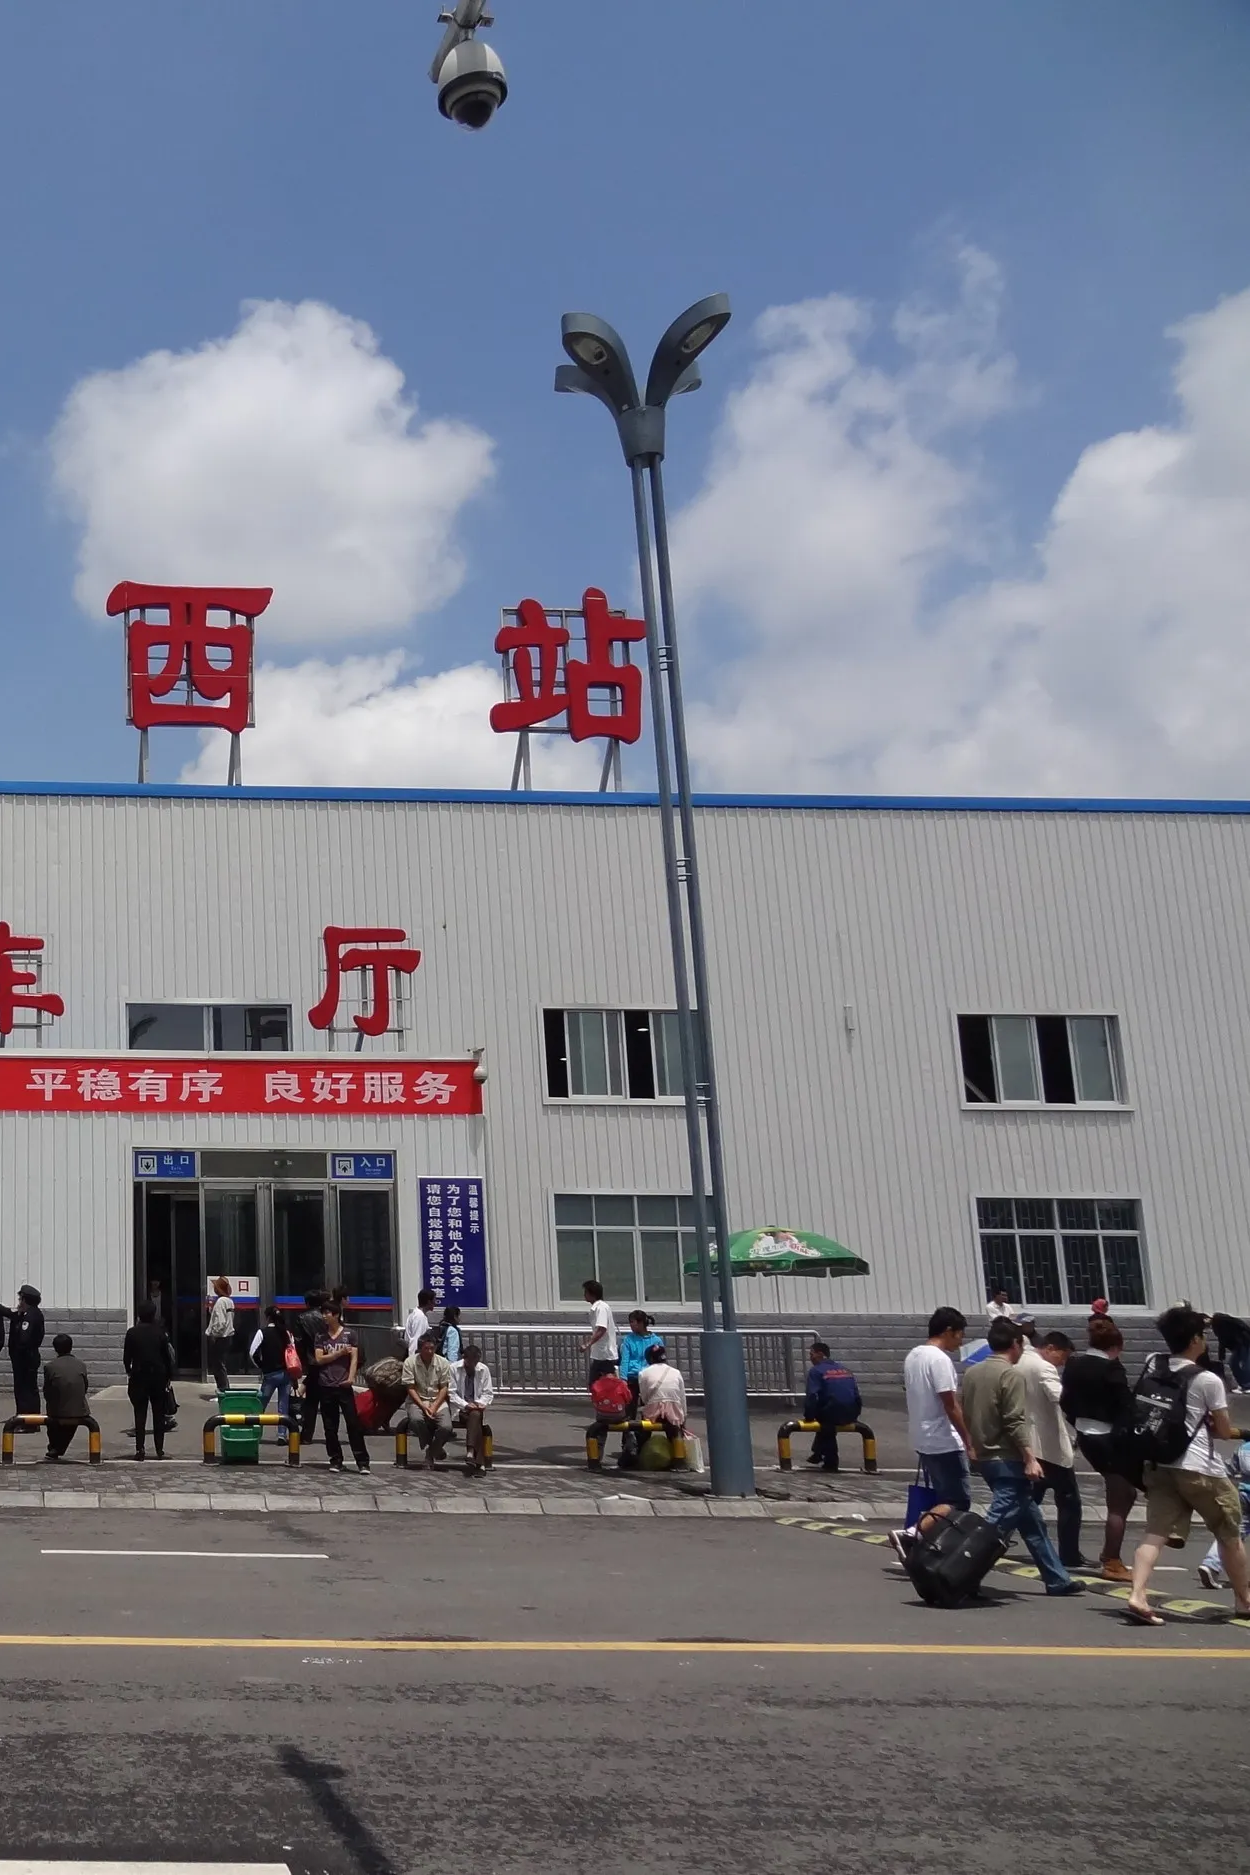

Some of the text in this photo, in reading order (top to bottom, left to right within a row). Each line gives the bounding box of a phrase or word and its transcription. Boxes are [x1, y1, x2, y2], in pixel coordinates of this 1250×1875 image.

[25, 1067, 224, 1104] 平稳有序
[264, 1070, 458, 1106] 良好服务
[163, 1154, 189, 1165] 出口
[360, 1156, 386, 1167] 入口
[468, 1184, 480, 1234] 温馨提示
